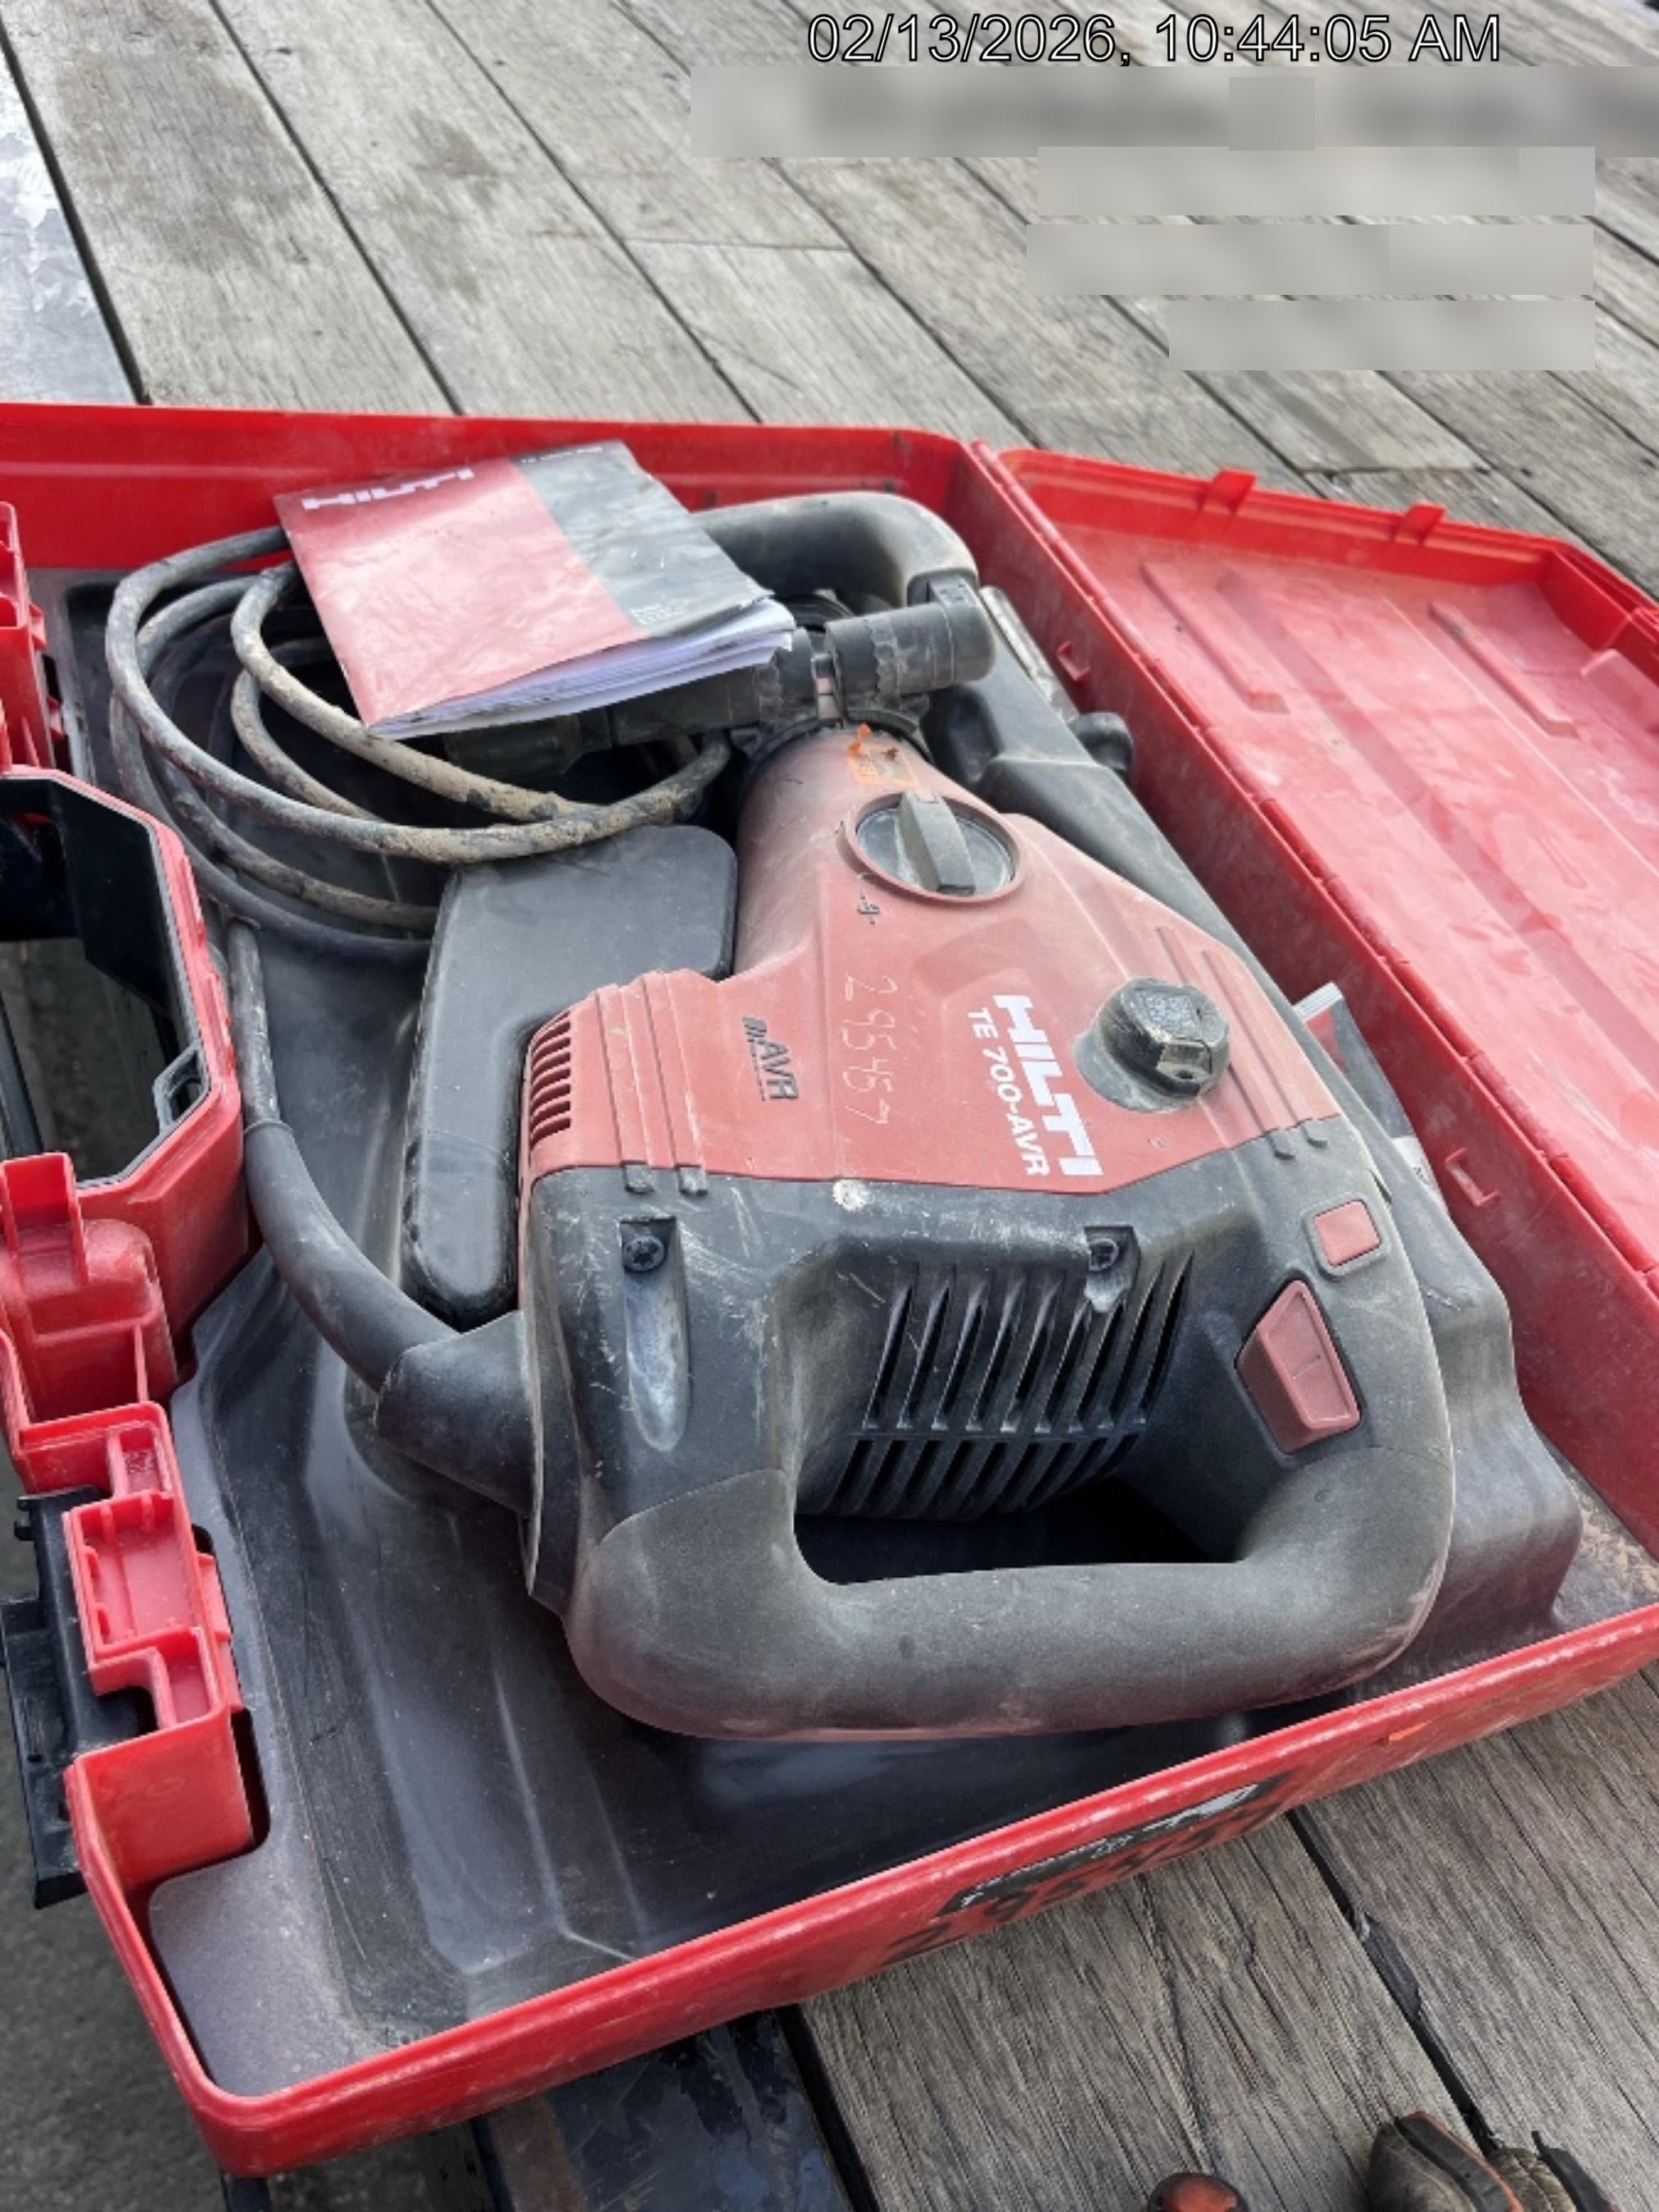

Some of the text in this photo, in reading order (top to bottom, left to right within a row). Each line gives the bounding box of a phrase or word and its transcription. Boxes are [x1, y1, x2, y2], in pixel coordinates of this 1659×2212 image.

[301, 468, 474, 510] HILTI
[754, 1037, 800, 1099] AVR
[841, 972, 898, 1124] 295457
[968, 1008, 1050, 1176] TE 700-AVR
[992, 995, 1104, 1176] HILTI
